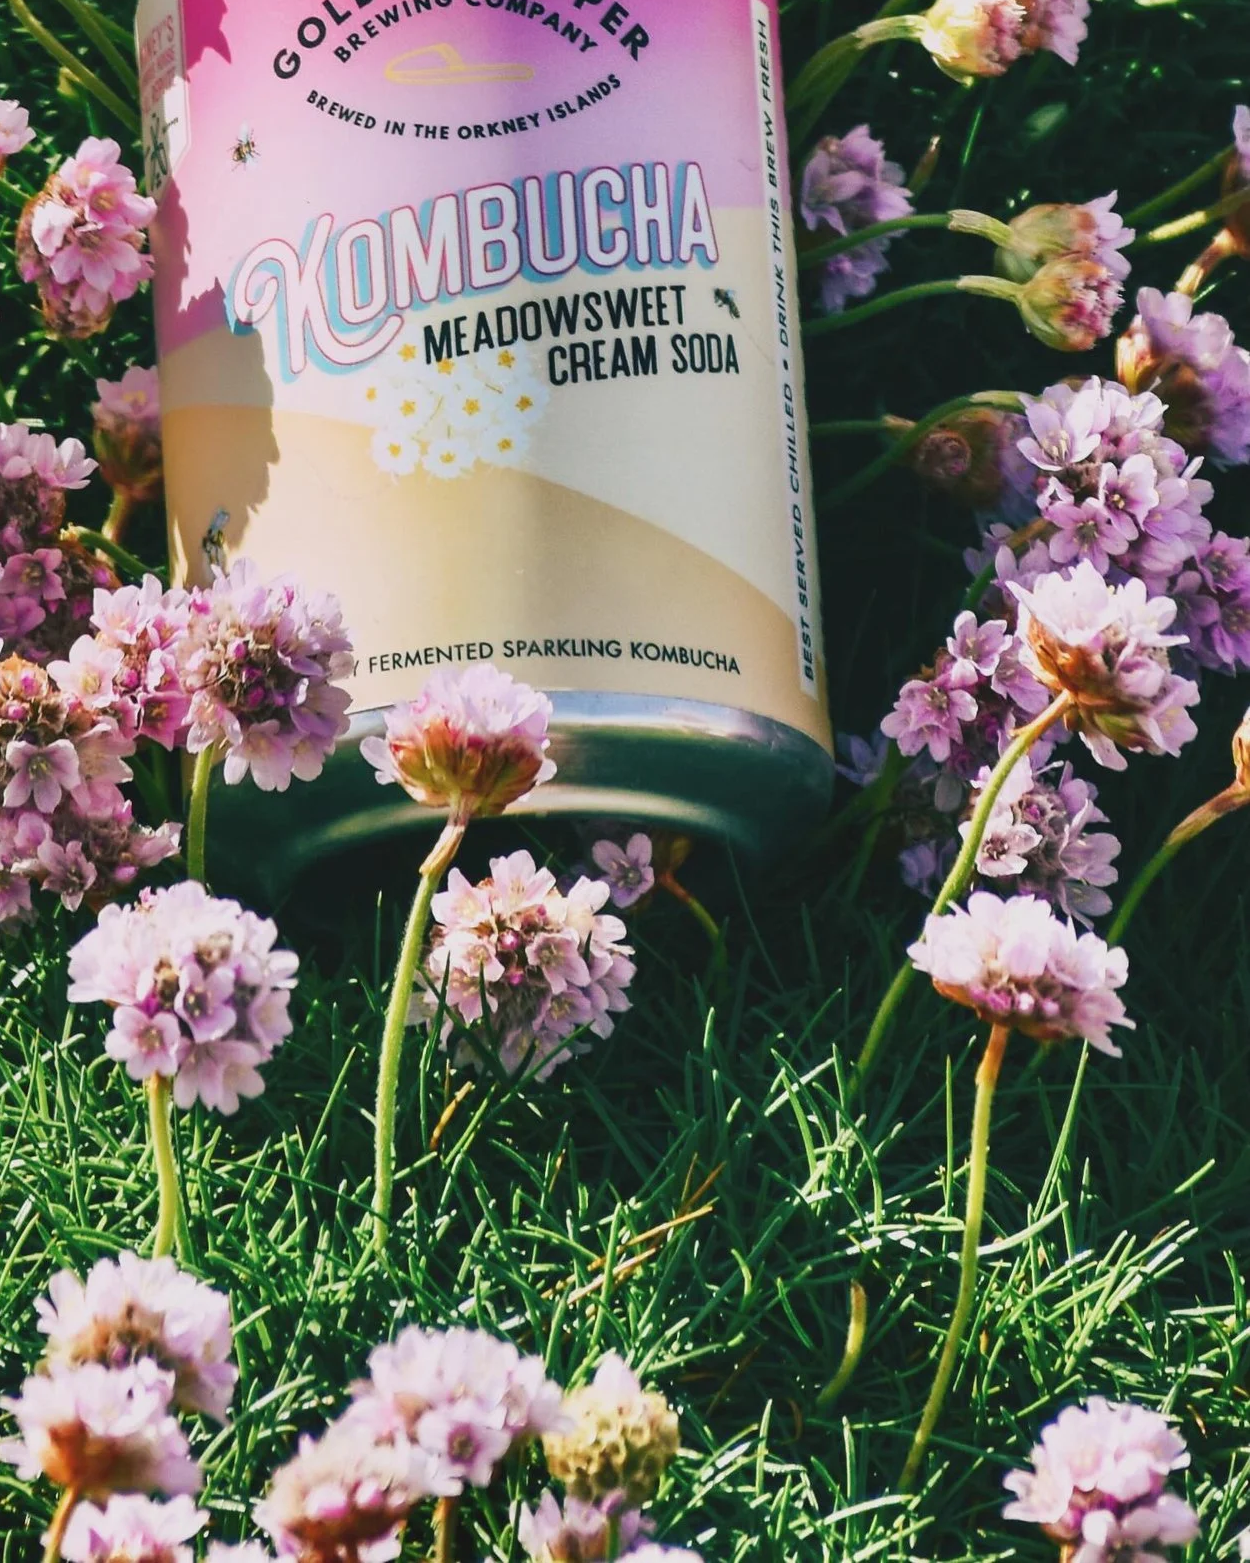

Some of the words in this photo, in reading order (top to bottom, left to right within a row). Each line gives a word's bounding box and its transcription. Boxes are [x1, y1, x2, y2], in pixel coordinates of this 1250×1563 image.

[757, 20, 771, 102] FRESH
[306, 89, 376, 130] BREWED
[384, 119, 405, 136] IN
[413, 123, 450, 140] THE
[457, 112, 541, 140] ORKNEY
[547, 73, 622, 123] ISLANDS
[763, 111, 777, 188] BREW
[769, 198, 781, 254] THIS
[228, 161, 720, 379] KOMBUCHA
[773, 264, 788, 348] DRINK
[422, 284, 686, 365] MEADOWSWEET
[548, 335, 658, 387] CREAM
[671, 333, 740, 376] SODA
[783, 383, 799, 493] CHILLED
[792, 504, 808, 607] SERVED
[368, 641, 494, 674] FERMENTED
[502, 638, 623, 659] SPARKLING
[631, 641, 741, 675] KOMBUCHA
[801, 619, 814, 682] BEST
